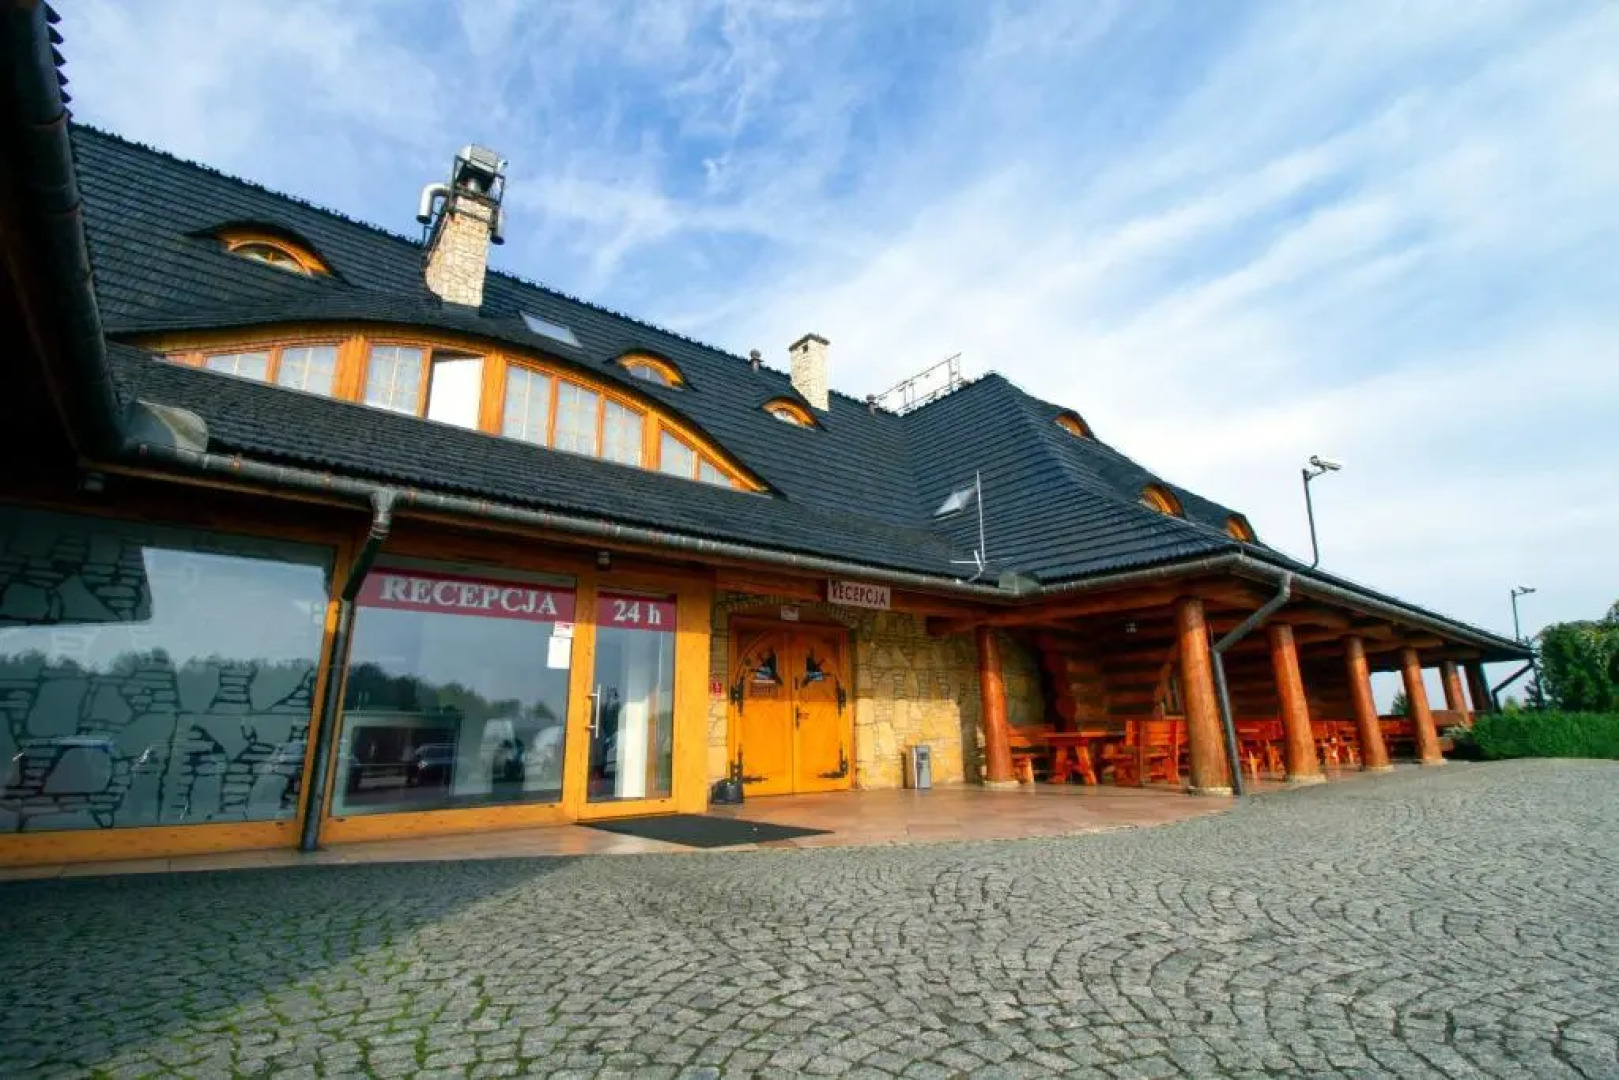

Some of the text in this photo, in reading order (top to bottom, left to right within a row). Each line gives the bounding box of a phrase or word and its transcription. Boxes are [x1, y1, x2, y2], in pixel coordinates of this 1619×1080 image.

[380, 576, 558, 615] RECEPCJA
[614, 600, 661, 624] 24 h
